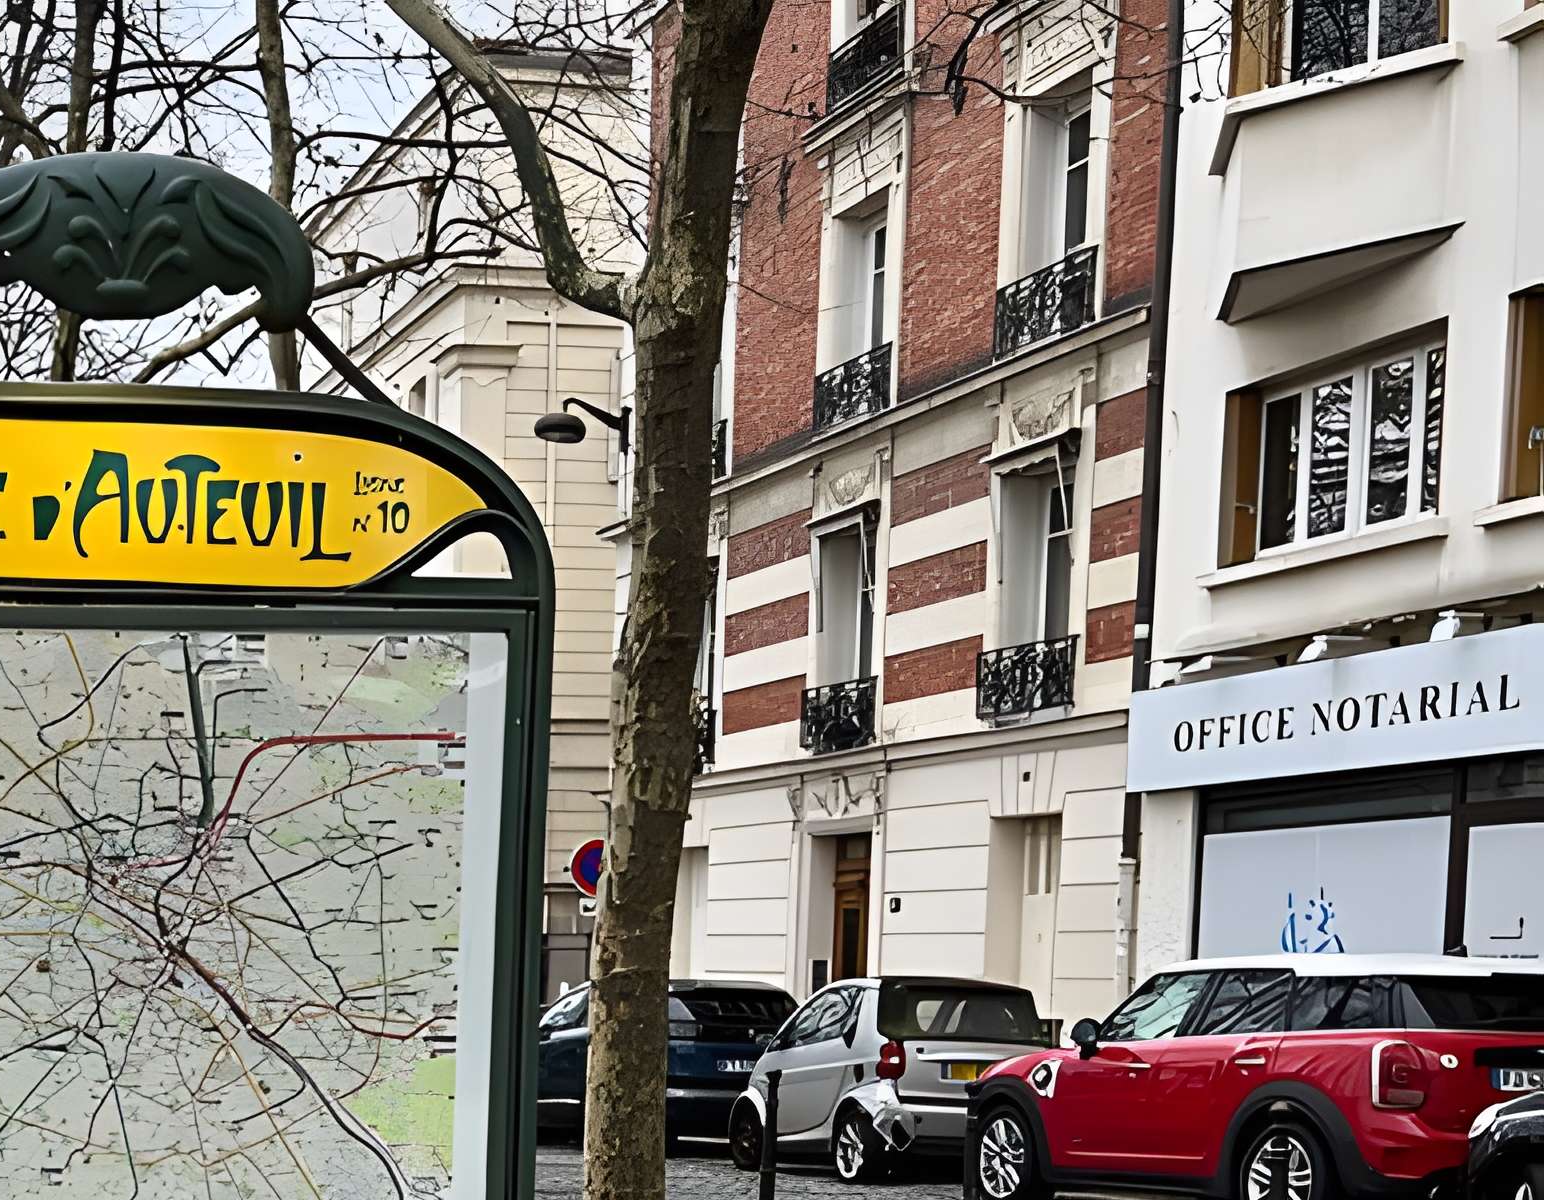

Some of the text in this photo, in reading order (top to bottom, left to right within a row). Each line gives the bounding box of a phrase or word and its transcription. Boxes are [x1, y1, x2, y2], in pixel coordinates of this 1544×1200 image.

[377, 500, 410, 534] 10
[1173, 673, 1521, 752] OFFICE NOTARIAL
